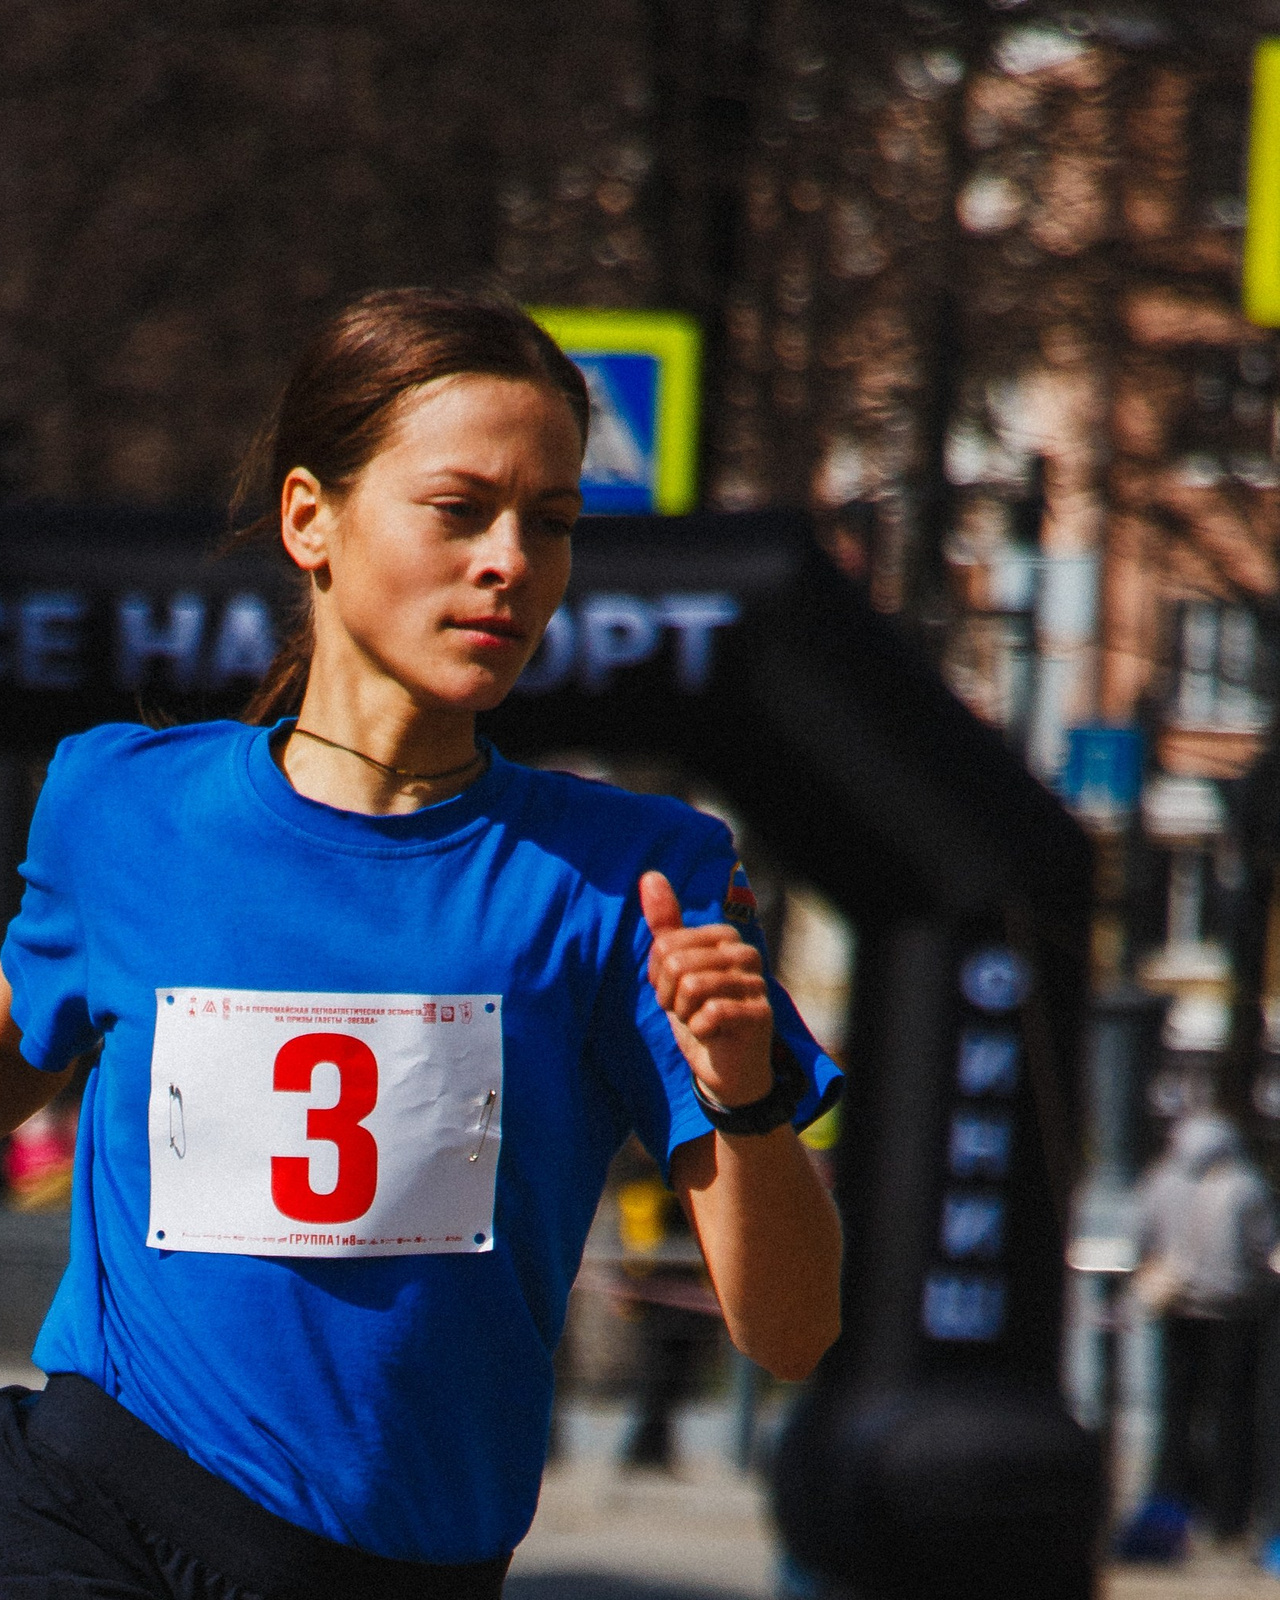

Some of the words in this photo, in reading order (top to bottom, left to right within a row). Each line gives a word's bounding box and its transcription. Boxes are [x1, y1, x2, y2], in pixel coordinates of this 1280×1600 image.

[120, 592, 282, 688] НА
[512, 591, 740, 690] ОРТ
[270, 1032, 379, 1225] 3
